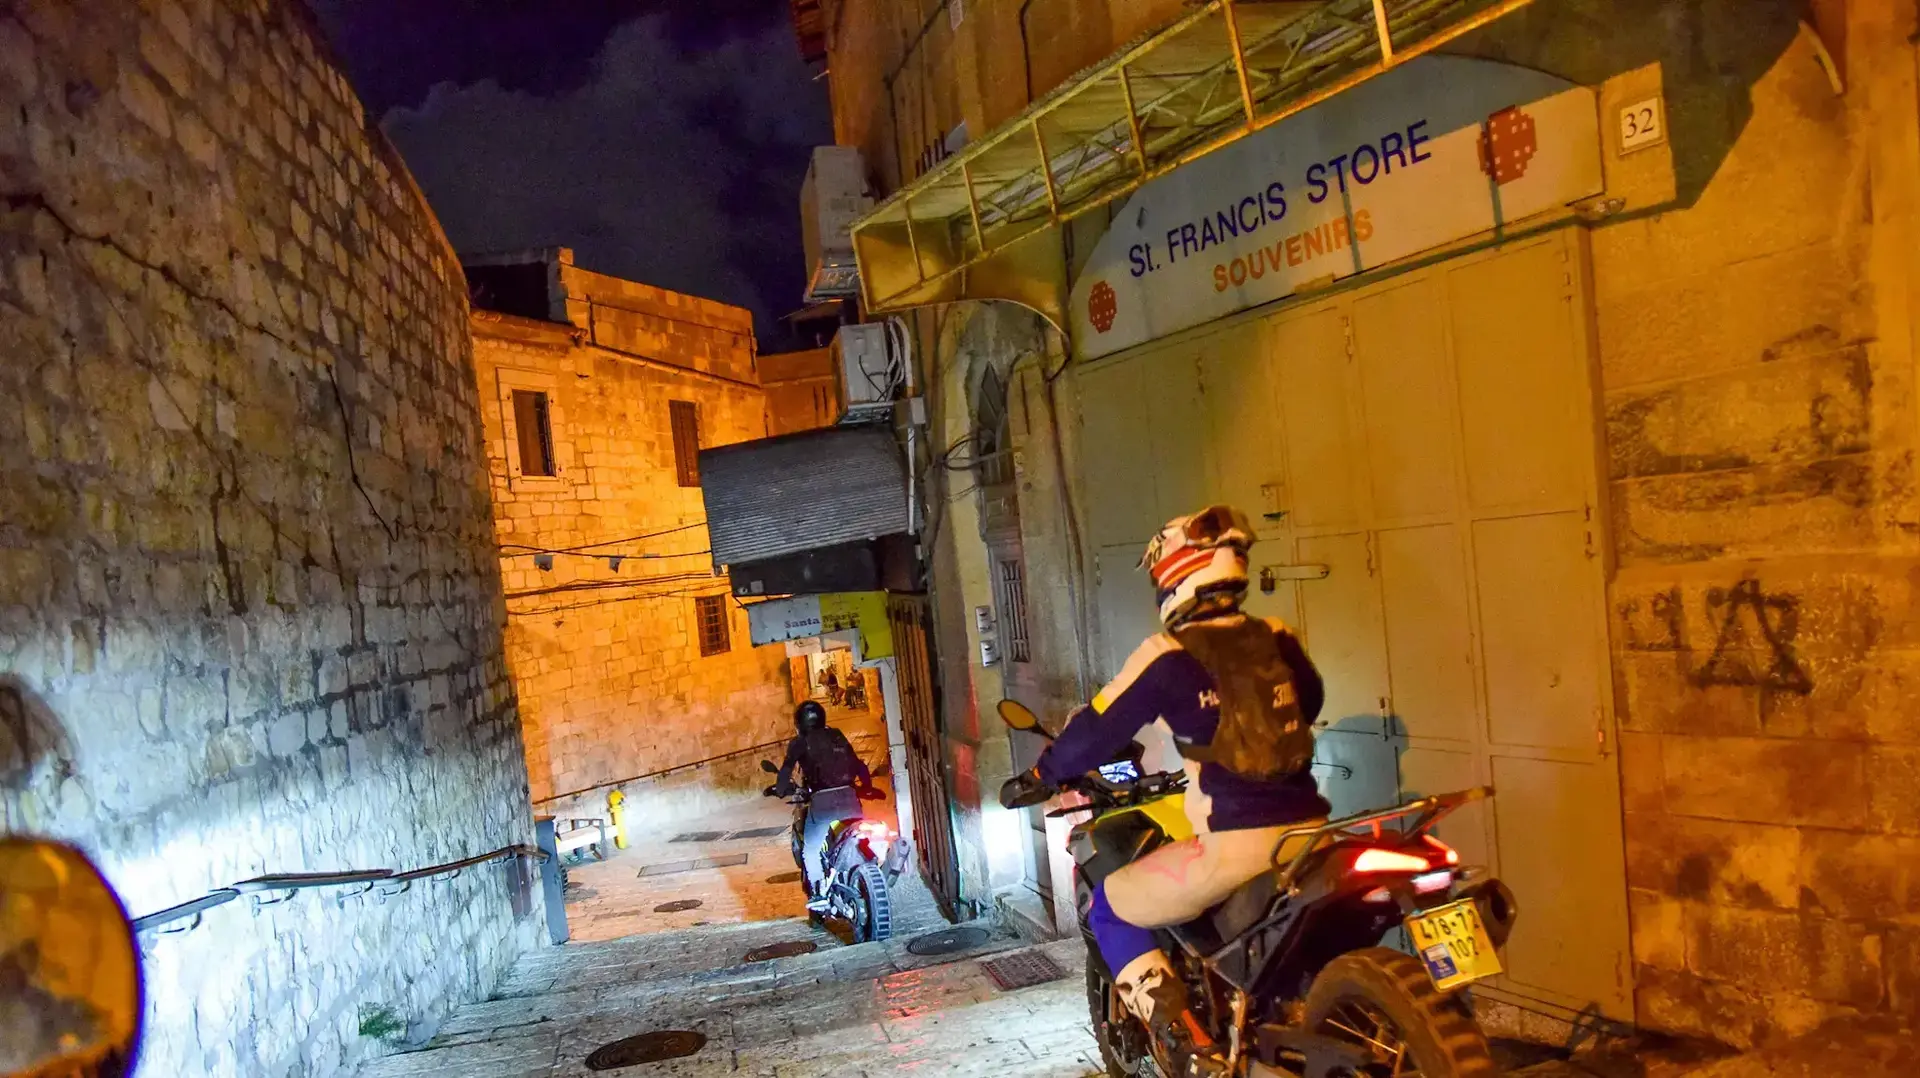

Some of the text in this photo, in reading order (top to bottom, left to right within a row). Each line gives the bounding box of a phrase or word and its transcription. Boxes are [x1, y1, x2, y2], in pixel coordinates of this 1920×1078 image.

[1623, 107, 1656, 139] 32
[1128, 118, 1432, 278] St. FRANCIS STORE
[1212, 208, 1374, 292] SOUVENIRS
[783, 616, 821, 629] Santa
[1448, 935, 1480, 960] 102
